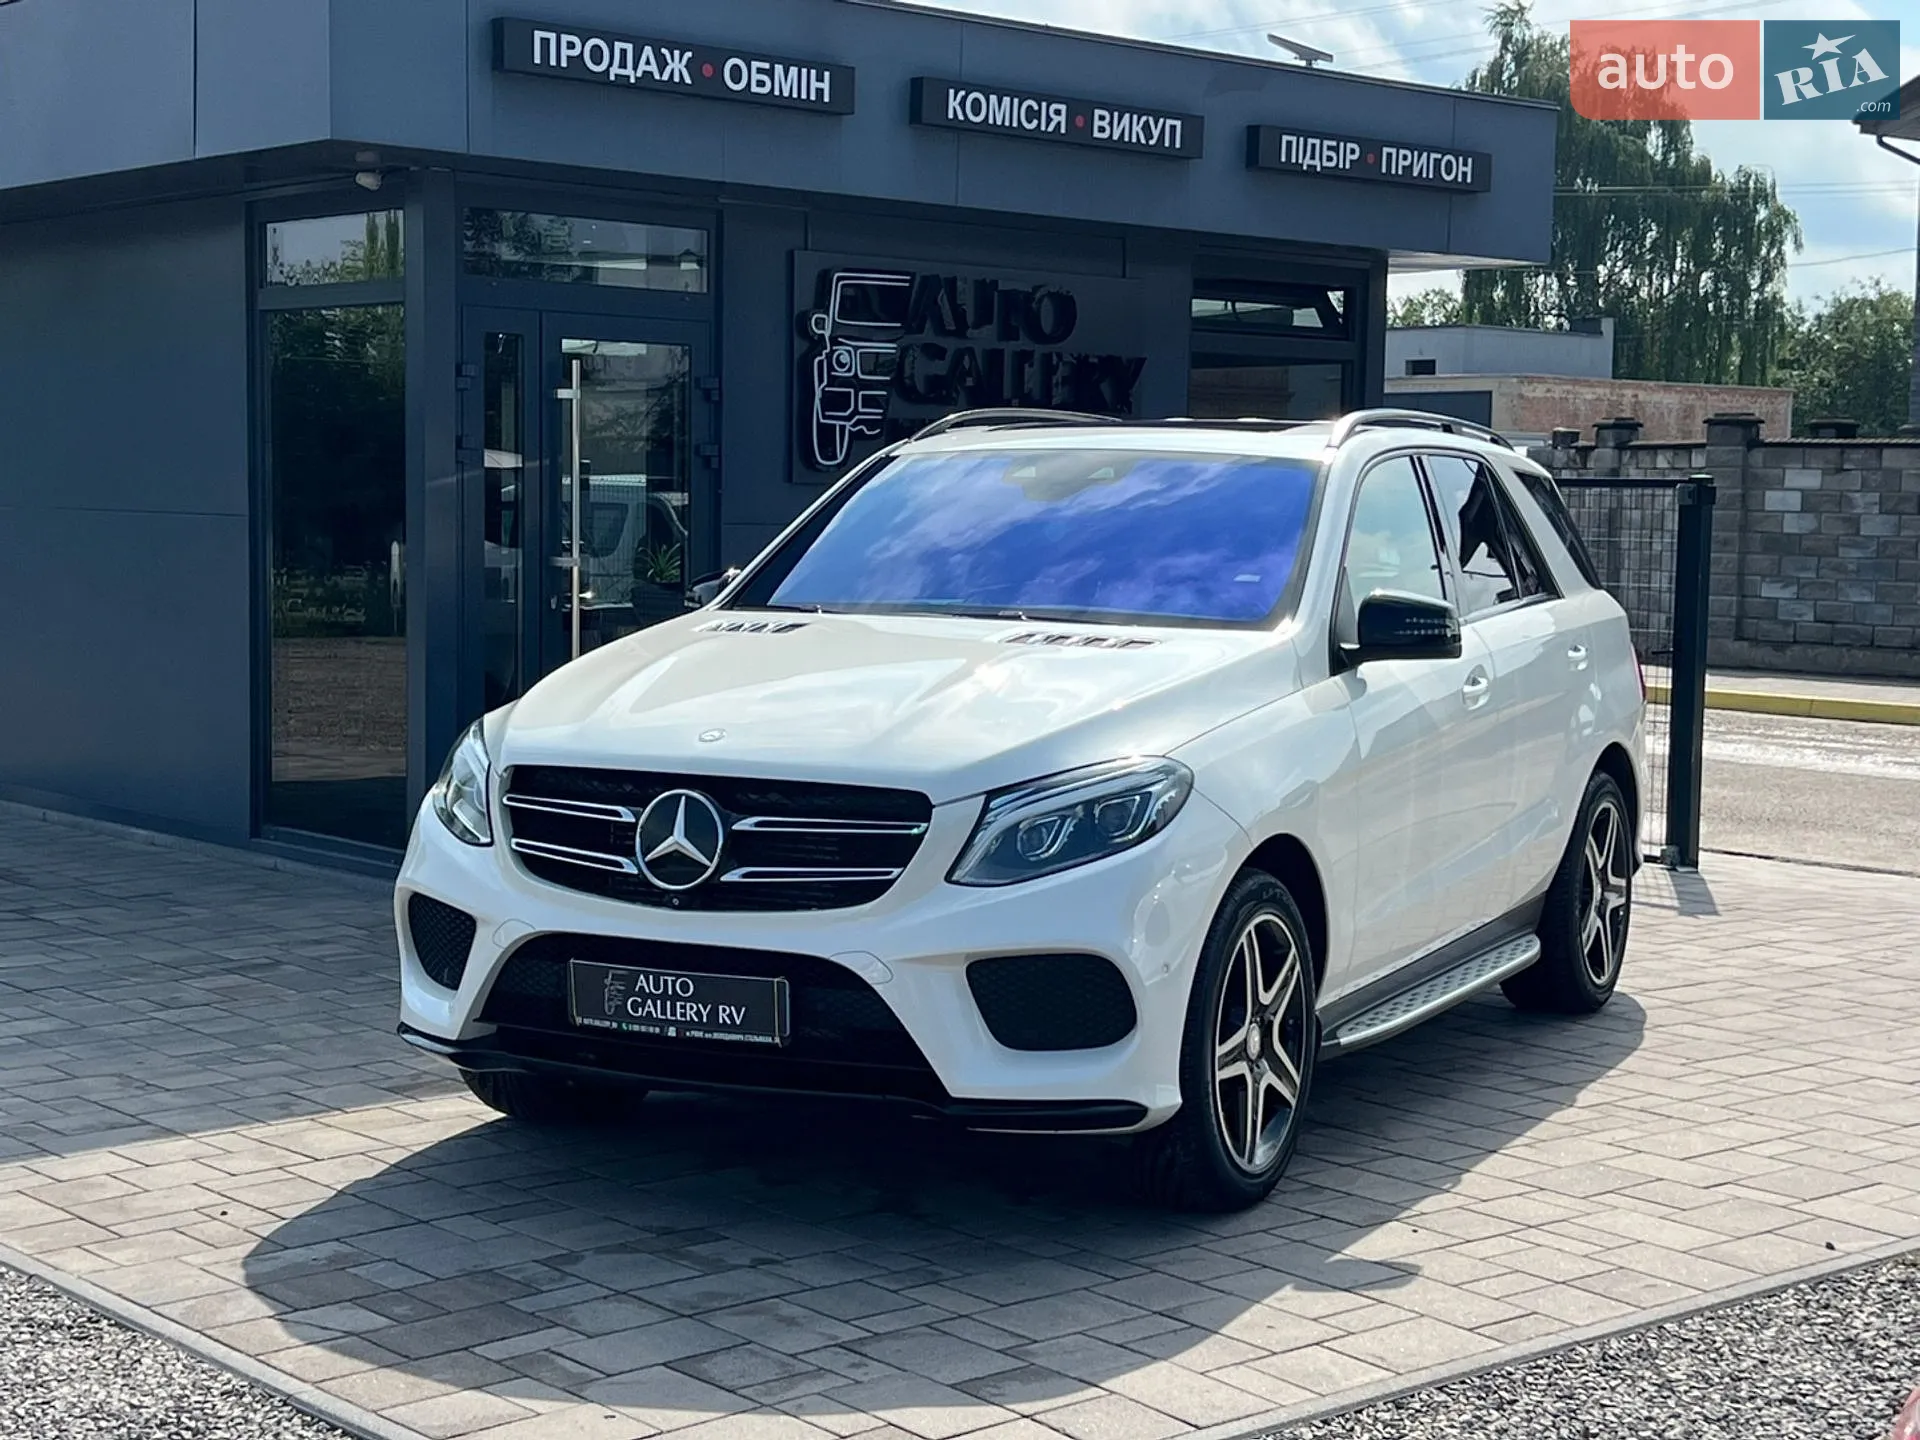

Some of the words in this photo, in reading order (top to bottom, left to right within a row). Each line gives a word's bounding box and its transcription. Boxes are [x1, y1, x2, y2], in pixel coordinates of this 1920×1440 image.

[533, 30, 693, 84] ПРОДАЖ
[723, 57, 830, 102] ОБМІН
[947, 88, 1067, 134] КОМІСІЯ
[1092, 108, 1182, 149] ВИКУП
[1280, 134, 1361, 172] ПІДБІР
[1381, 146, 1473, 184] ПРИГОН
[908, 274, 1077, 345] AUTO
[895, 343, 1147, 414] GALLERY
[626, 997, 712, 1025] GALLERY
[718, 1004, 746, 1025] RV
[634, 974, 695, 997] AUTO
